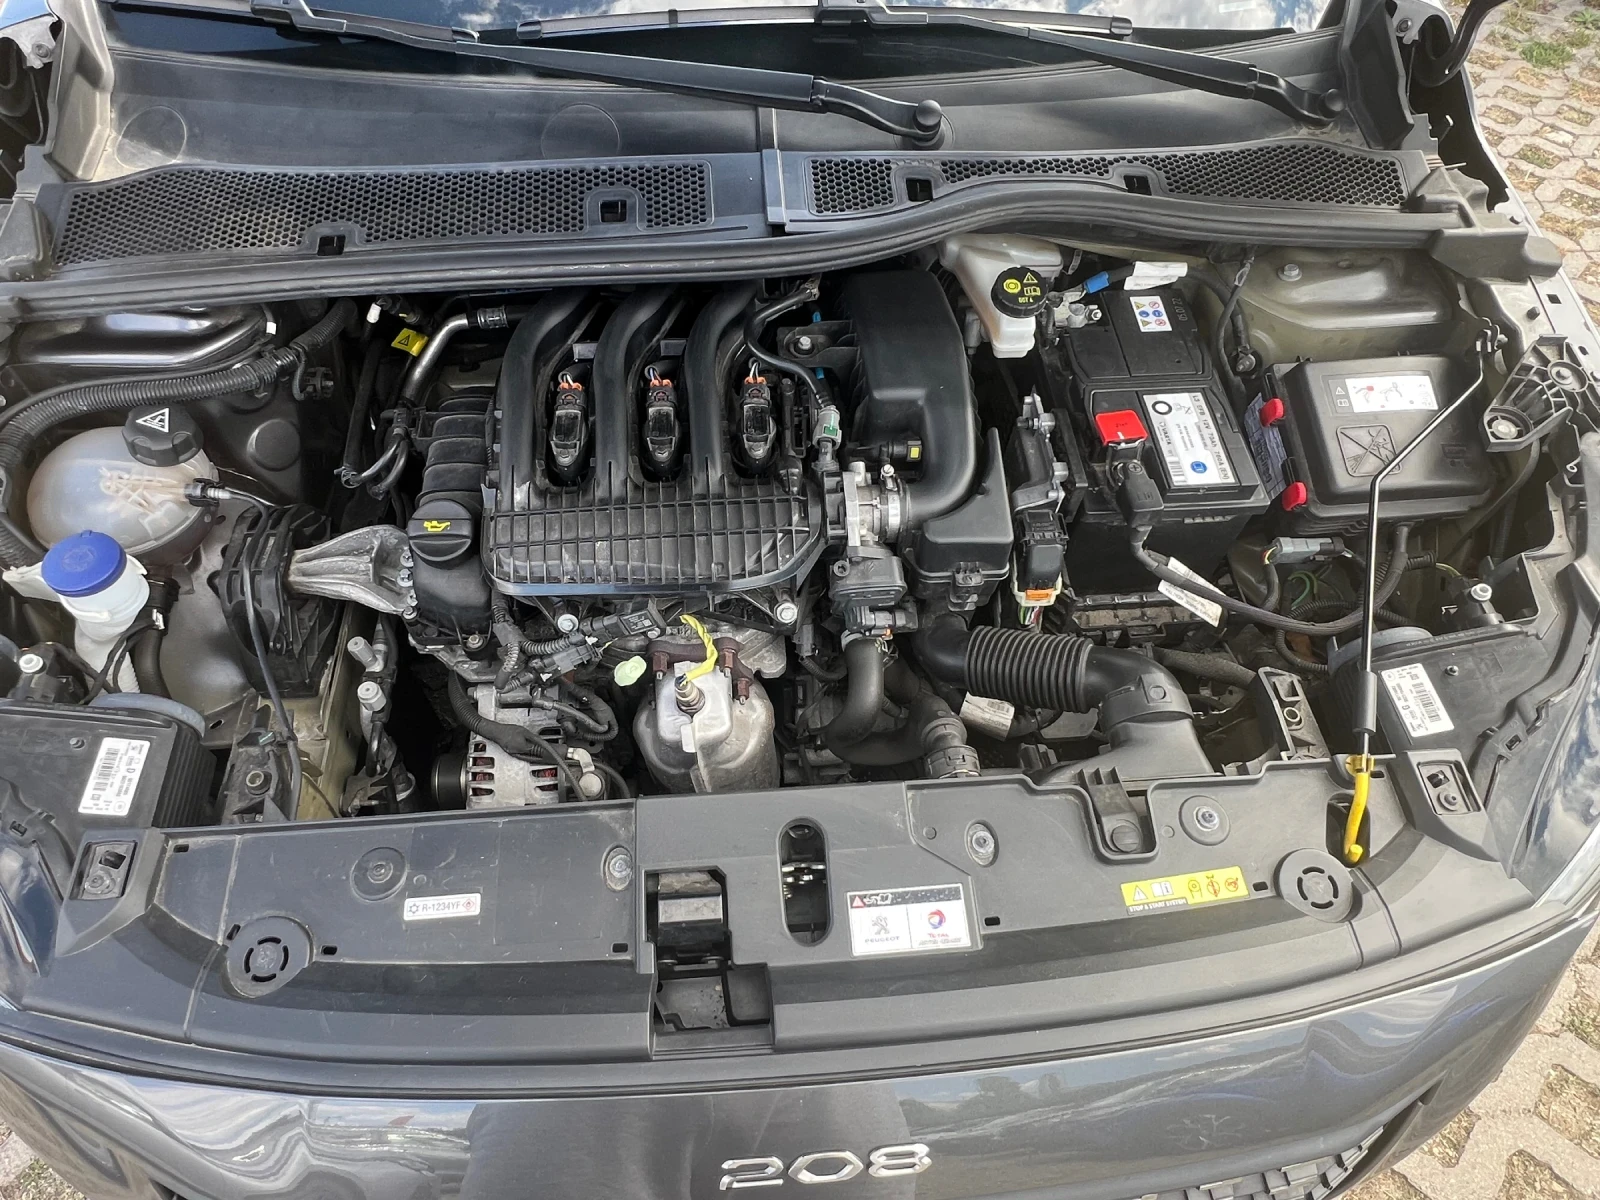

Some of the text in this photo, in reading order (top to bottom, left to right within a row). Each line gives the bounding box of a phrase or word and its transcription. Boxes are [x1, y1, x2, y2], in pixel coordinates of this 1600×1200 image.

[1202, 419, 1211, 430] 12V
[1162, 427, 1172, 445] VARTA
[421, 901, 461, 912] R-1234YF
[1149, 902, 1166, 910] START
[1166, 899, 1187, 907] SYSTEM
[864, 935, 900, 943] PEUGEOT
[719, 1143, 933, 1191] 208
